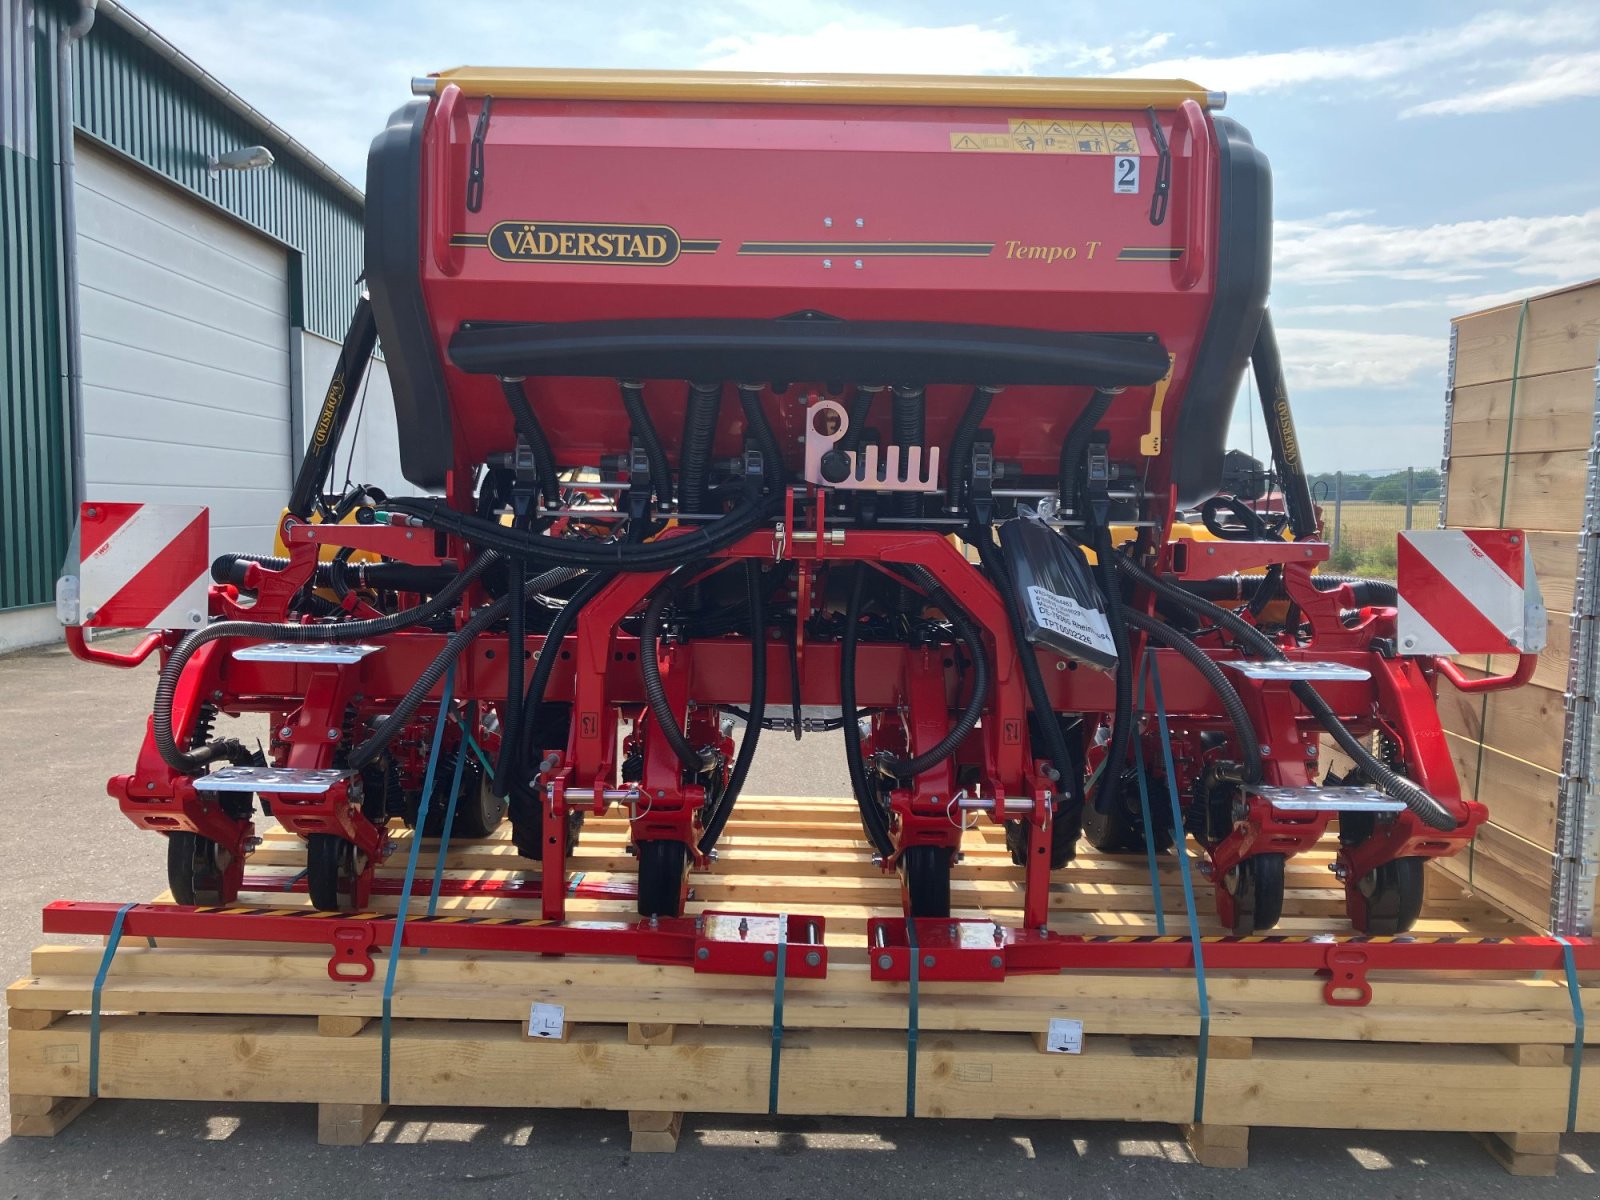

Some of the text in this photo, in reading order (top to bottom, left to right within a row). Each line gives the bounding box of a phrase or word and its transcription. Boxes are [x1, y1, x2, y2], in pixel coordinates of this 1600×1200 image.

[1118, 158, 1136, 186] 2
[503, 225, 667, 259] VÄDERSTAD
[1005, 240, 1102, 264] Tempo T
[316, 385, 341, 442] VÄDERSTAD
[1277, 401, 1297, 461] VÄDERSTAD
